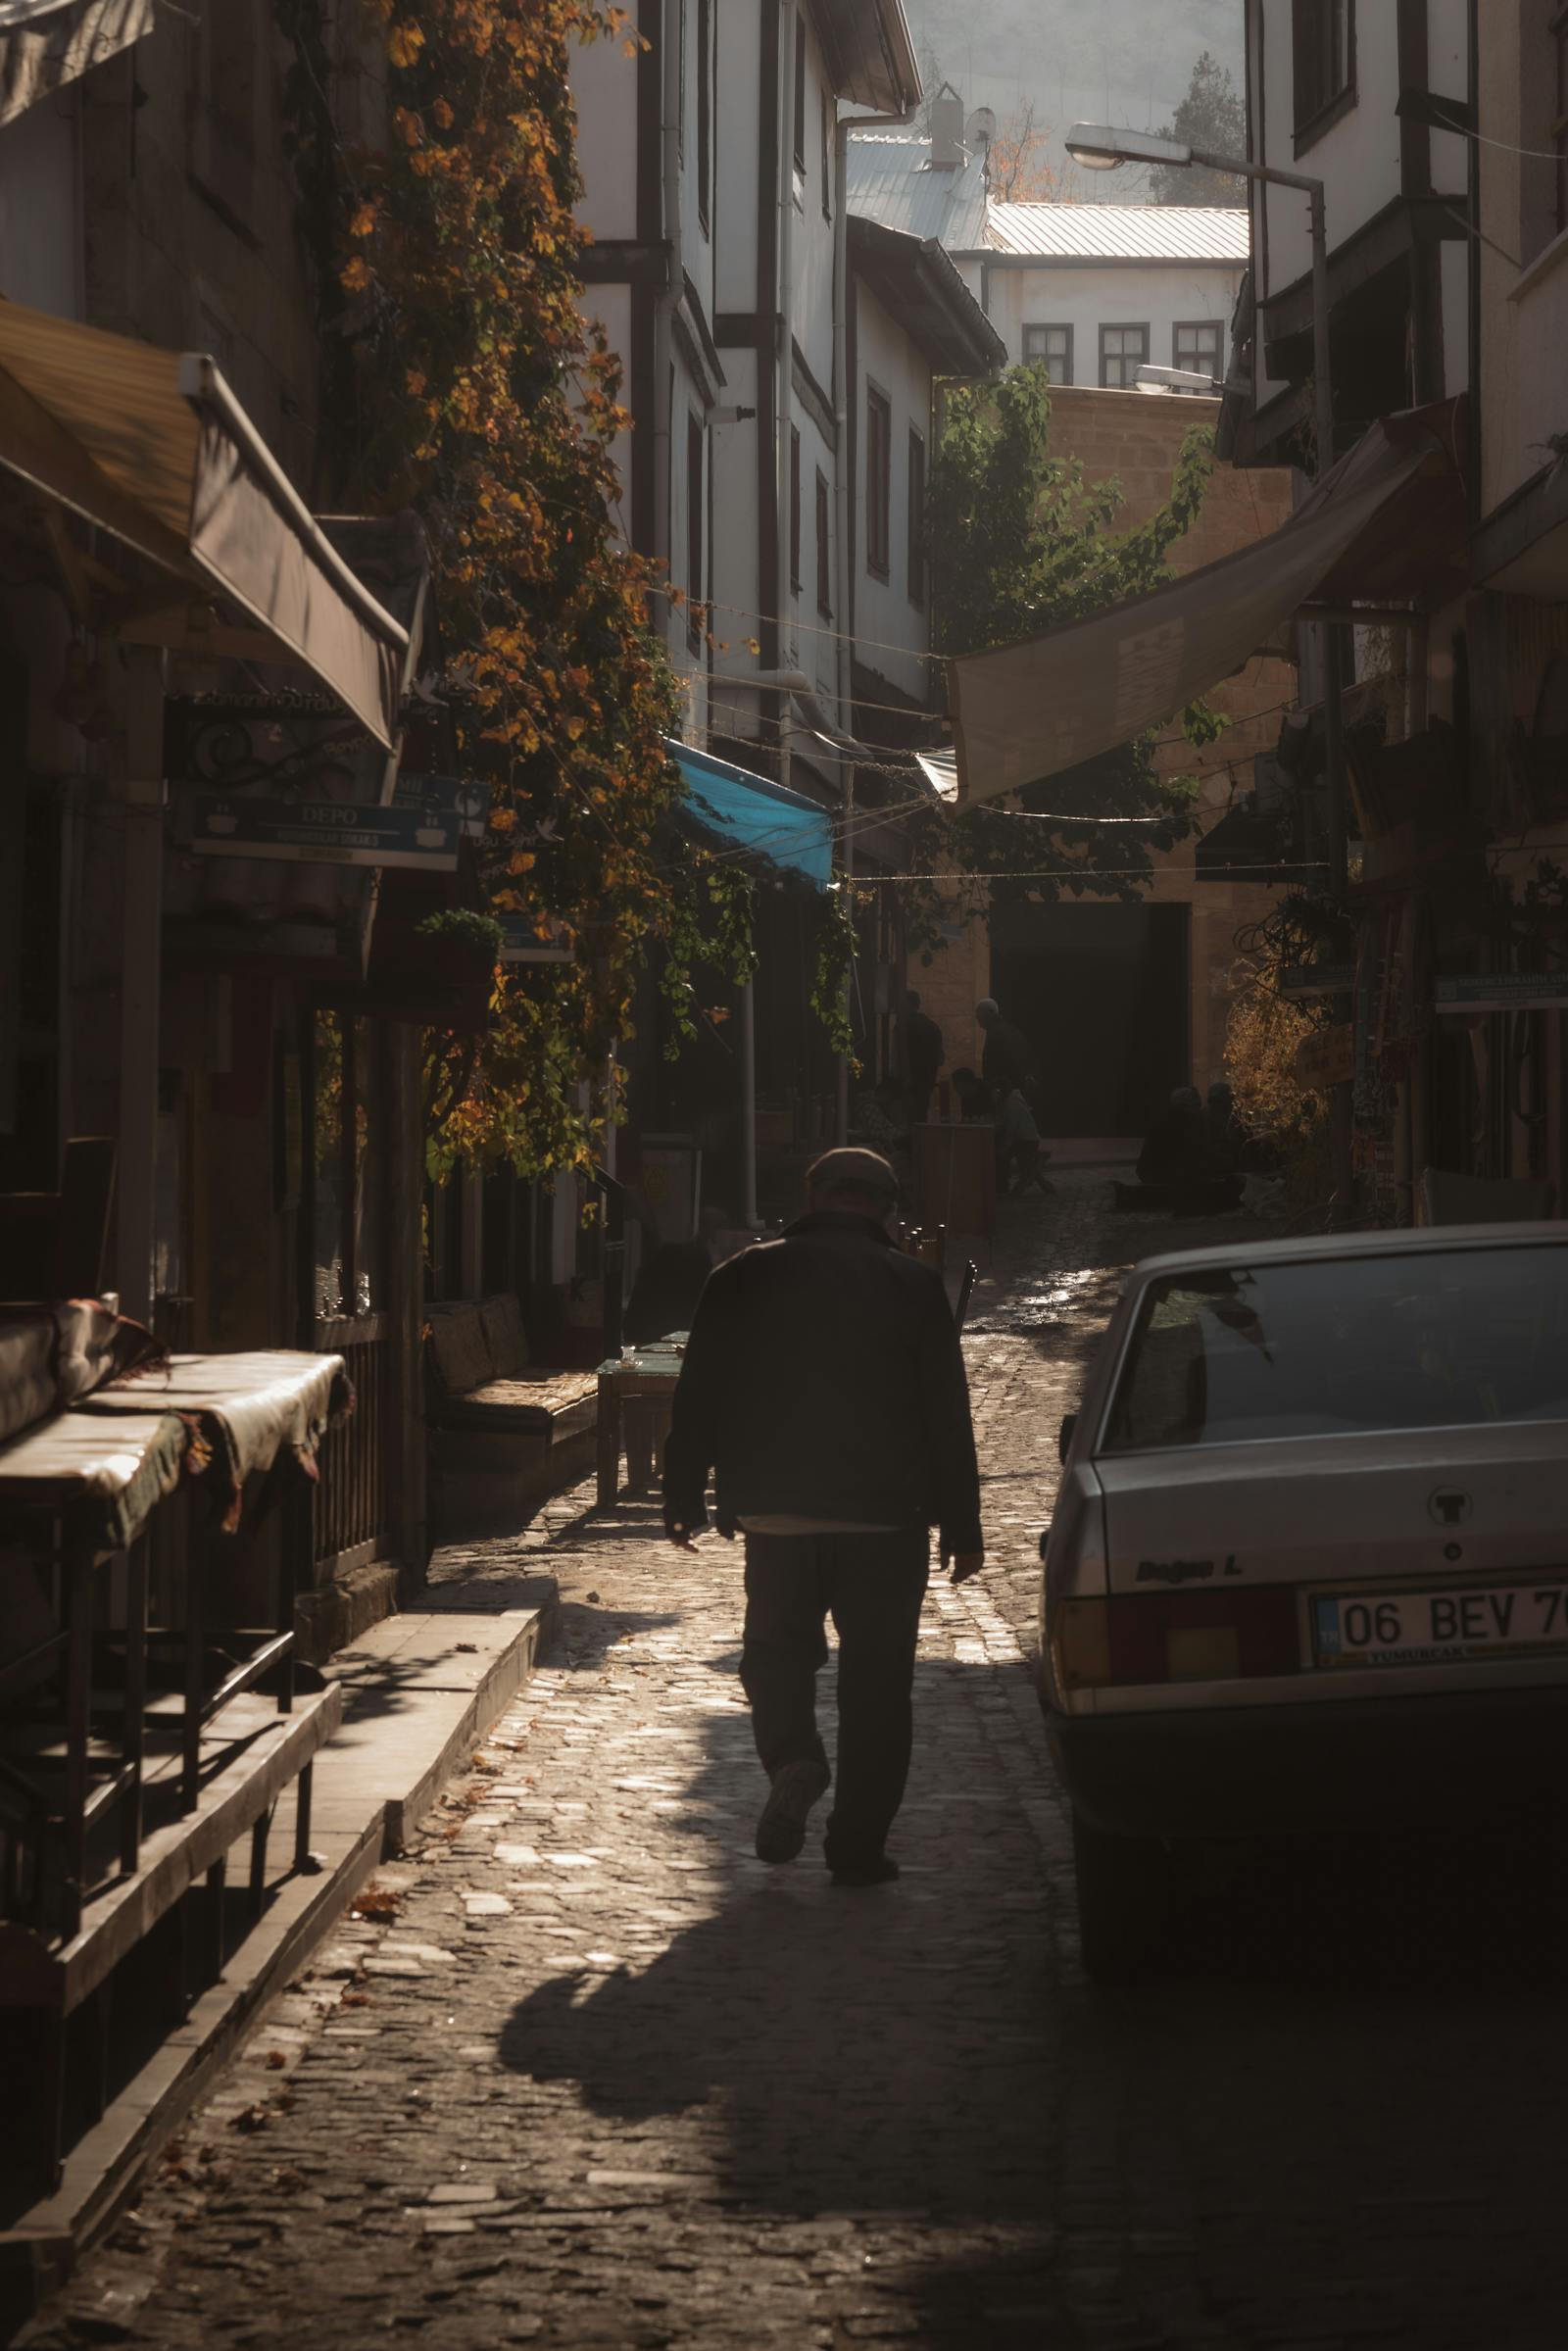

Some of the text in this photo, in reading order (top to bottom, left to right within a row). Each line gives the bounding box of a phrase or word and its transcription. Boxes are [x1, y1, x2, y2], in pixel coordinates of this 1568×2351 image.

[302, 807, 358, 825] DEPO
[1224, 1554, 1243, 1576] L
[1345, 1590, 1568, 1646] 06 BEV 7
[1372, 1645, 1465, 1664] YUMURCAK
